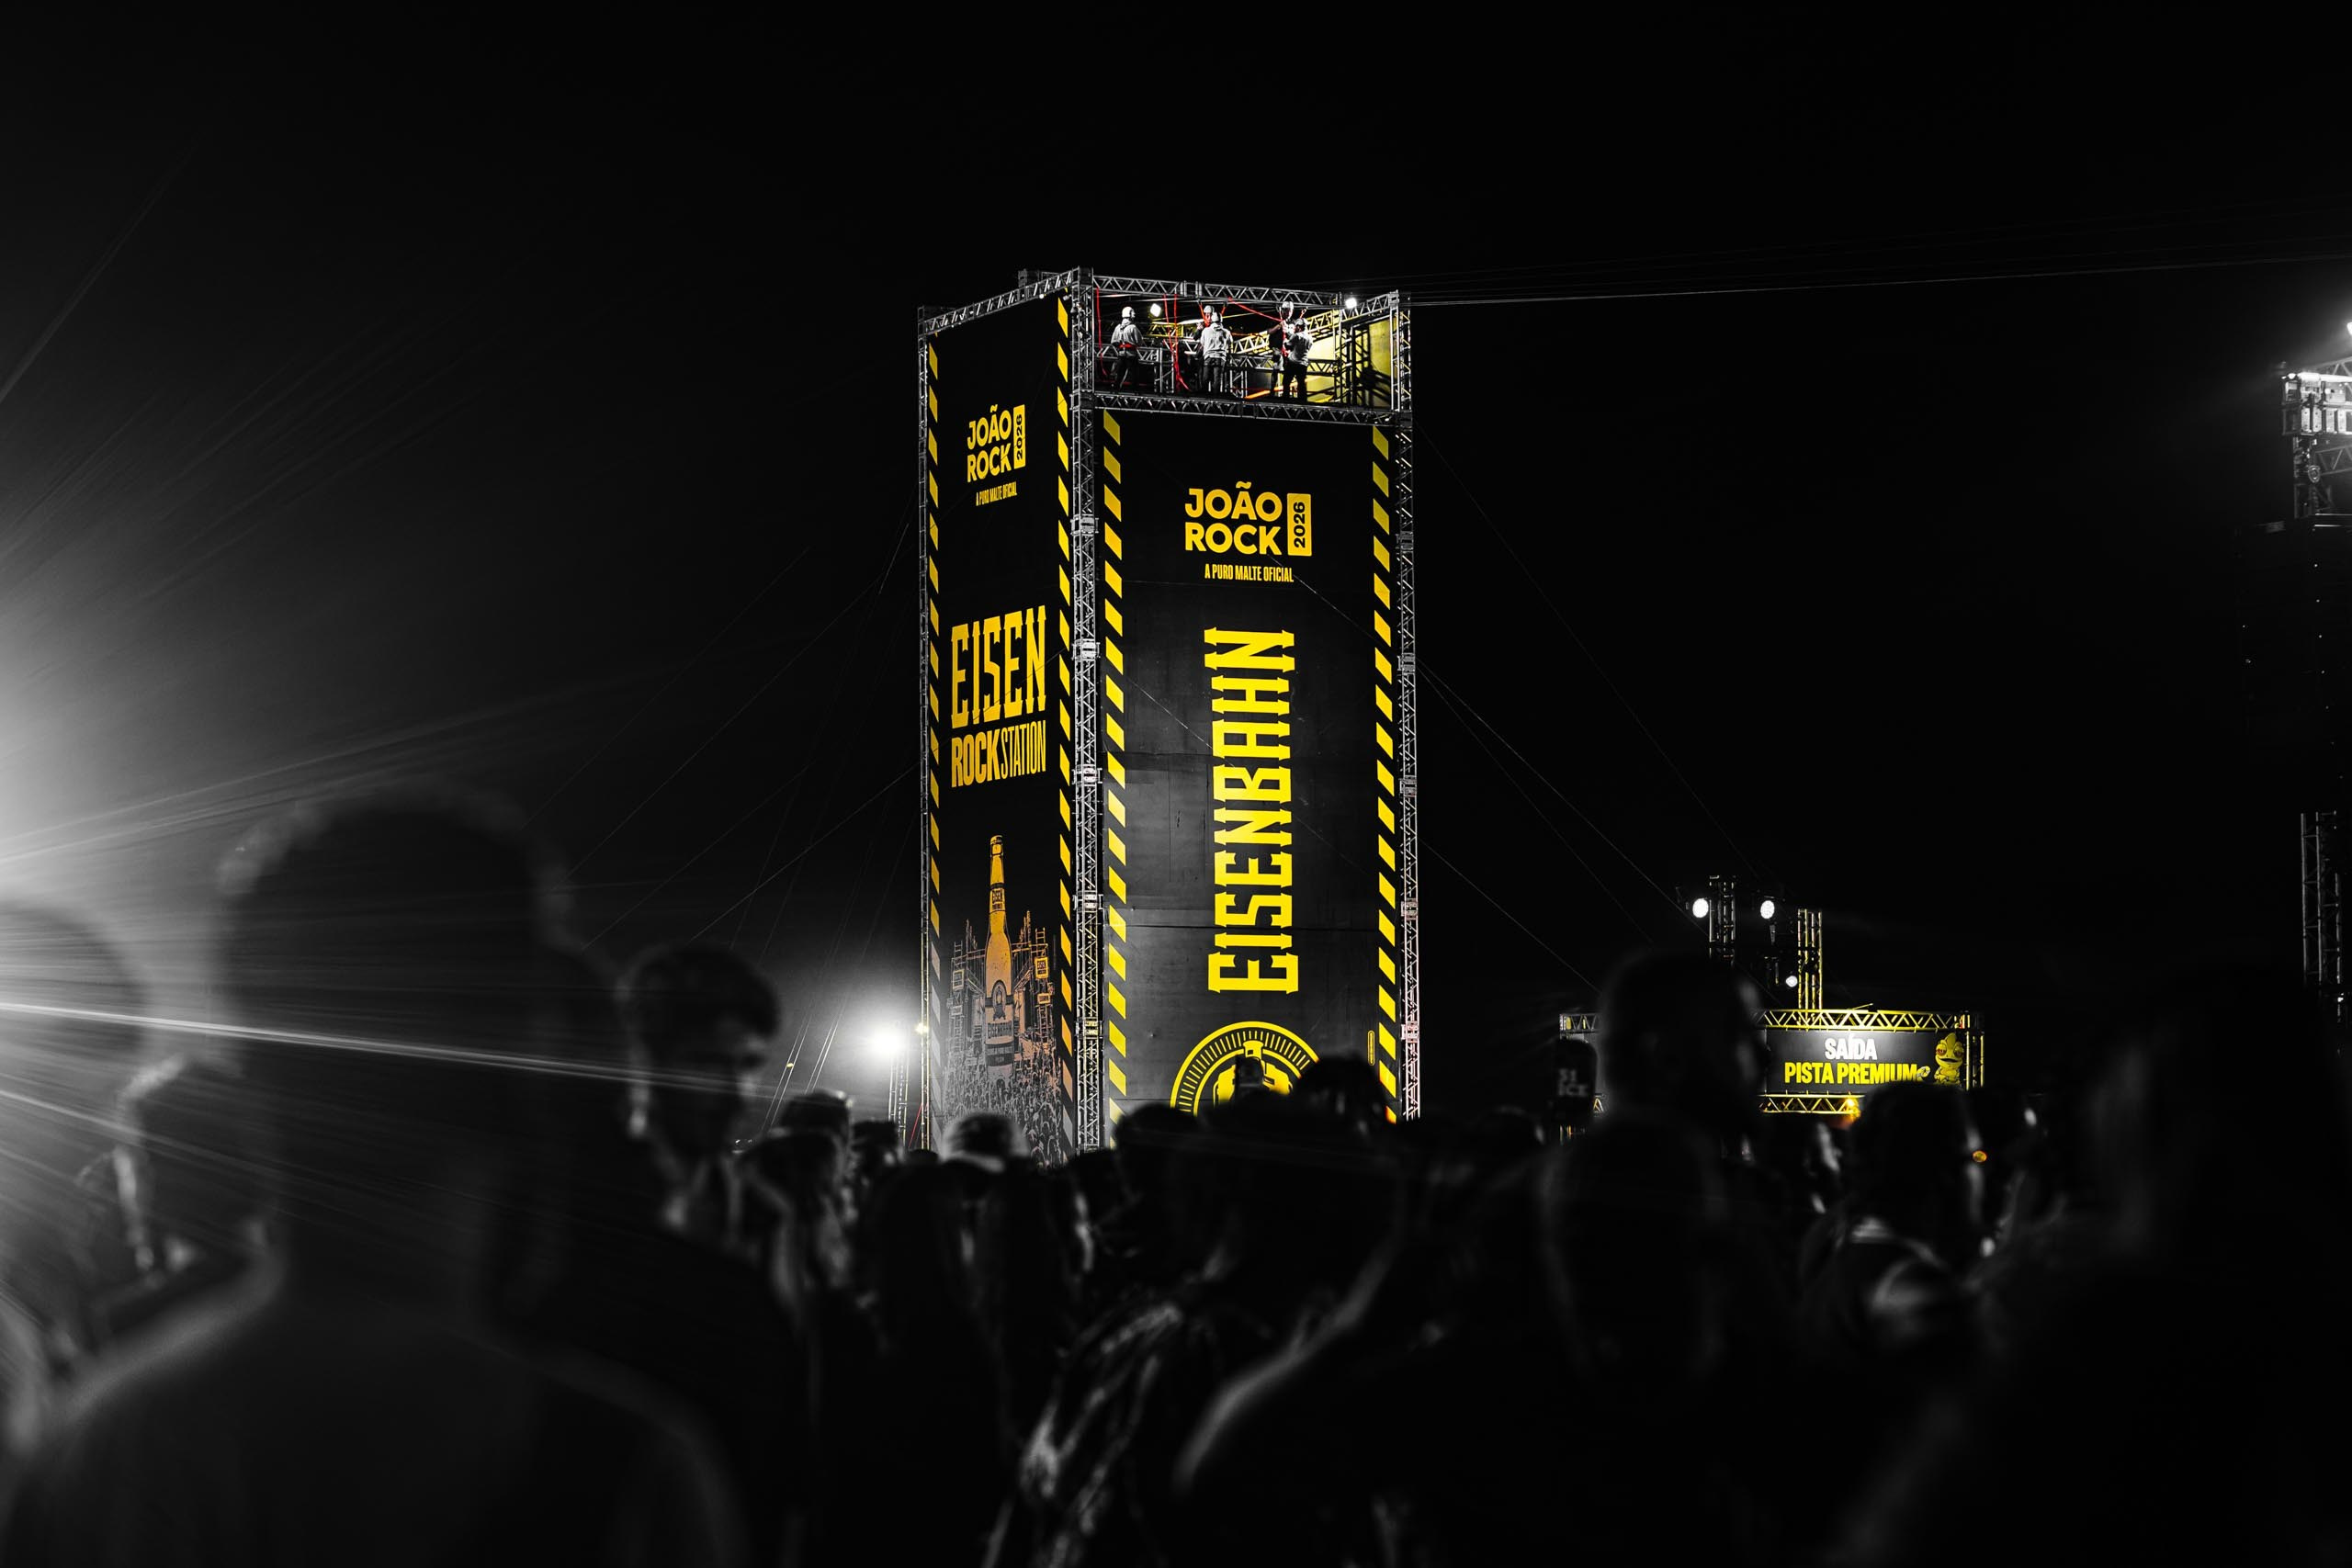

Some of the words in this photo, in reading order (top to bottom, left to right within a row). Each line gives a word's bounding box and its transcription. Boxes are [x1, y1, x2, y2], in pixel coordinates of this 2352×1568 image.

[967, 404, 1012, 450] JOÃO
[967, 443, 1012, 482] ROCK
[1185, 481, 1283, 522] JOÃO
[1185, 522, 1283, 556] ROCK
[1293, 502, 1306, 548] 2026
[1204, 563, 1211, 579] A
[1212, 564, 1234, 580] PURO
[1235, 565, 1262, 581] MALTE
[1263, 567, 1295, 582] OFICIAL
[951, 604, 1046, 728] EISEN
[1204, 627, 1299, 993] EISENBAHN
[1825, 1032, 1877, 1060] SAÍDA
[1784, 1062, 1834, 1084] PISTA
[1838, 1063, 1917, 1084] PREMIUM
